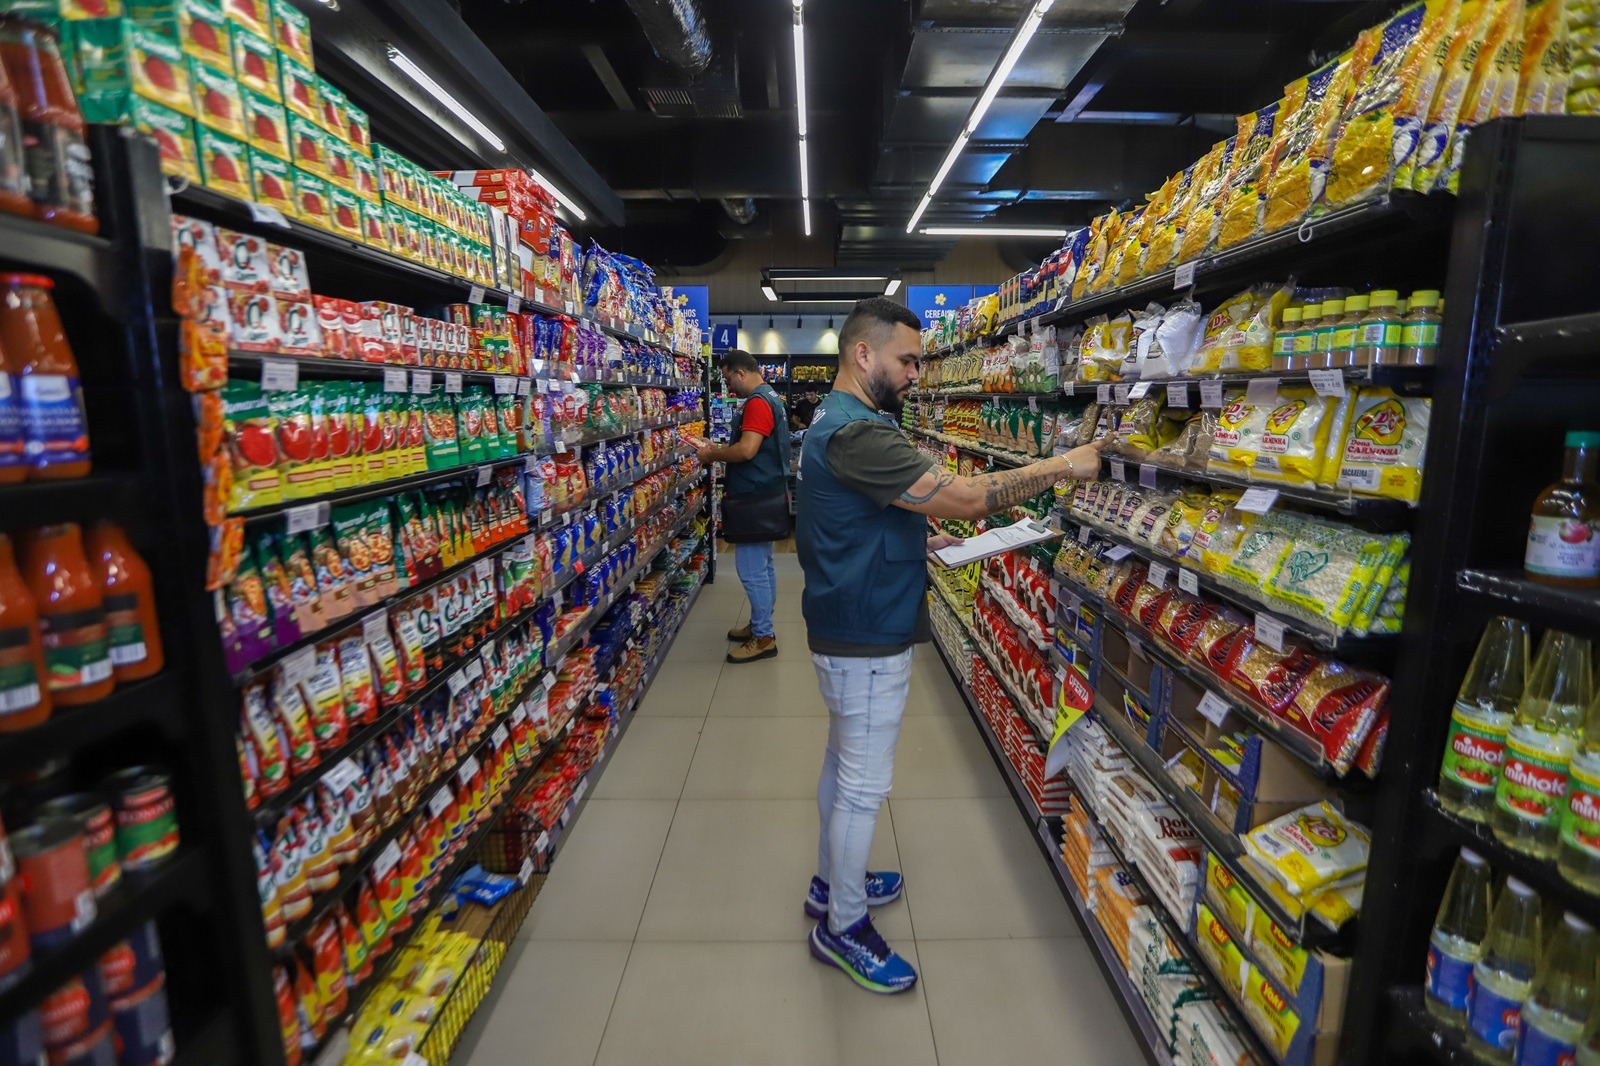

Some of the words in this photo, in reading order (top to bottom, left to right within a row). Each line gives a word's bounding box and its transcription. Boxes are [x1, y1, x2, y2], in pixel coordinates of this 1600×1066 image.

[681, 309, 696, 317] HOS
[721, 329, 729, 345] 4
[1347, 446, 1399, 456] CARMINHA
[1069, 674, 1089, 704] OFERTA
